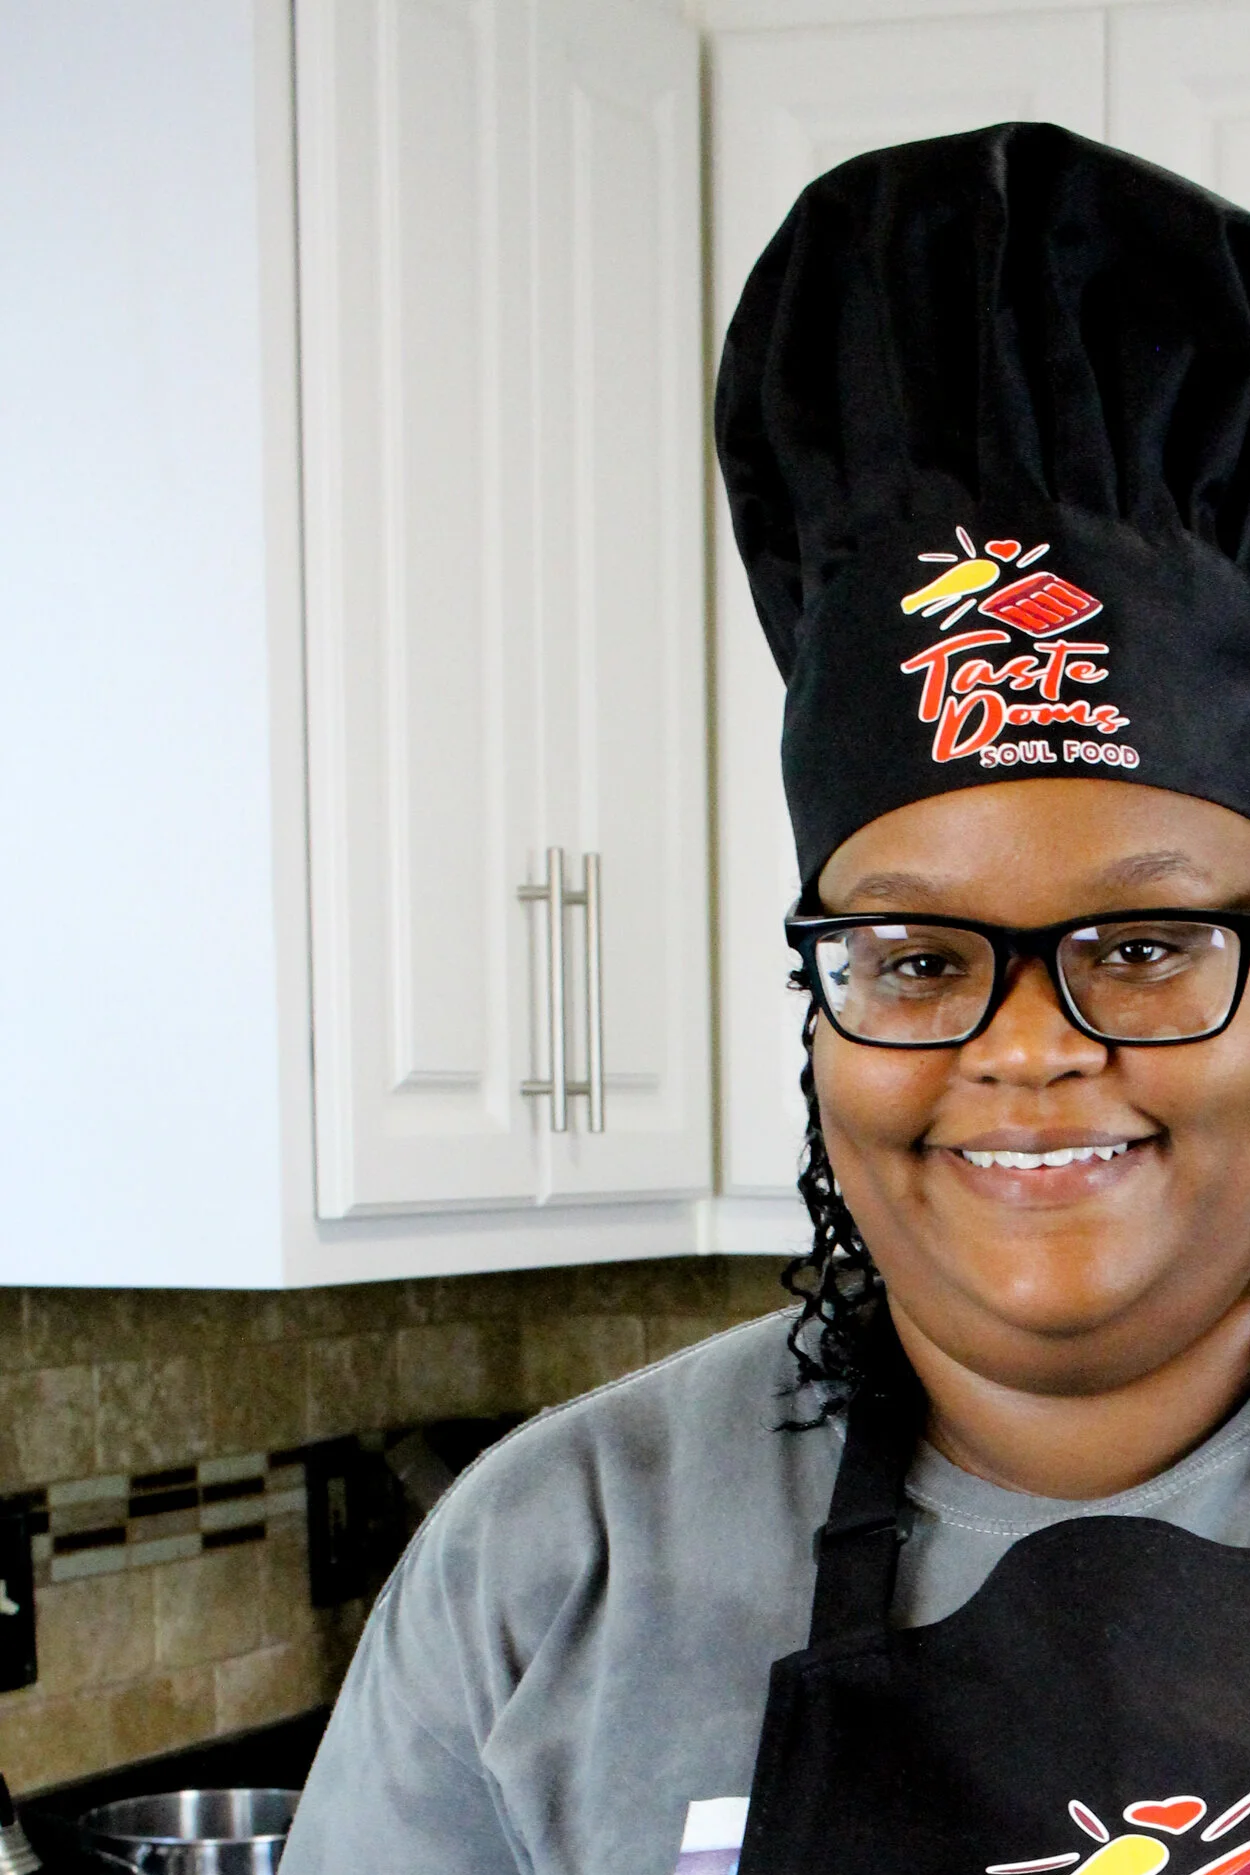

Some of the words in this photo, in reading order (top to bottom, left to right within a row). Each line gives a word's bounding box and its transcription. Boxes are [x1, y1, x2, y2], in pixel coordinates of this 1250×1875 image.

[900, 630, 1110, 722] Taste
[932, 690, 1130, 762] Doms
[980, 740, 1056, 768] SOUL
[1063, 740, 1140, 769] FOOD
